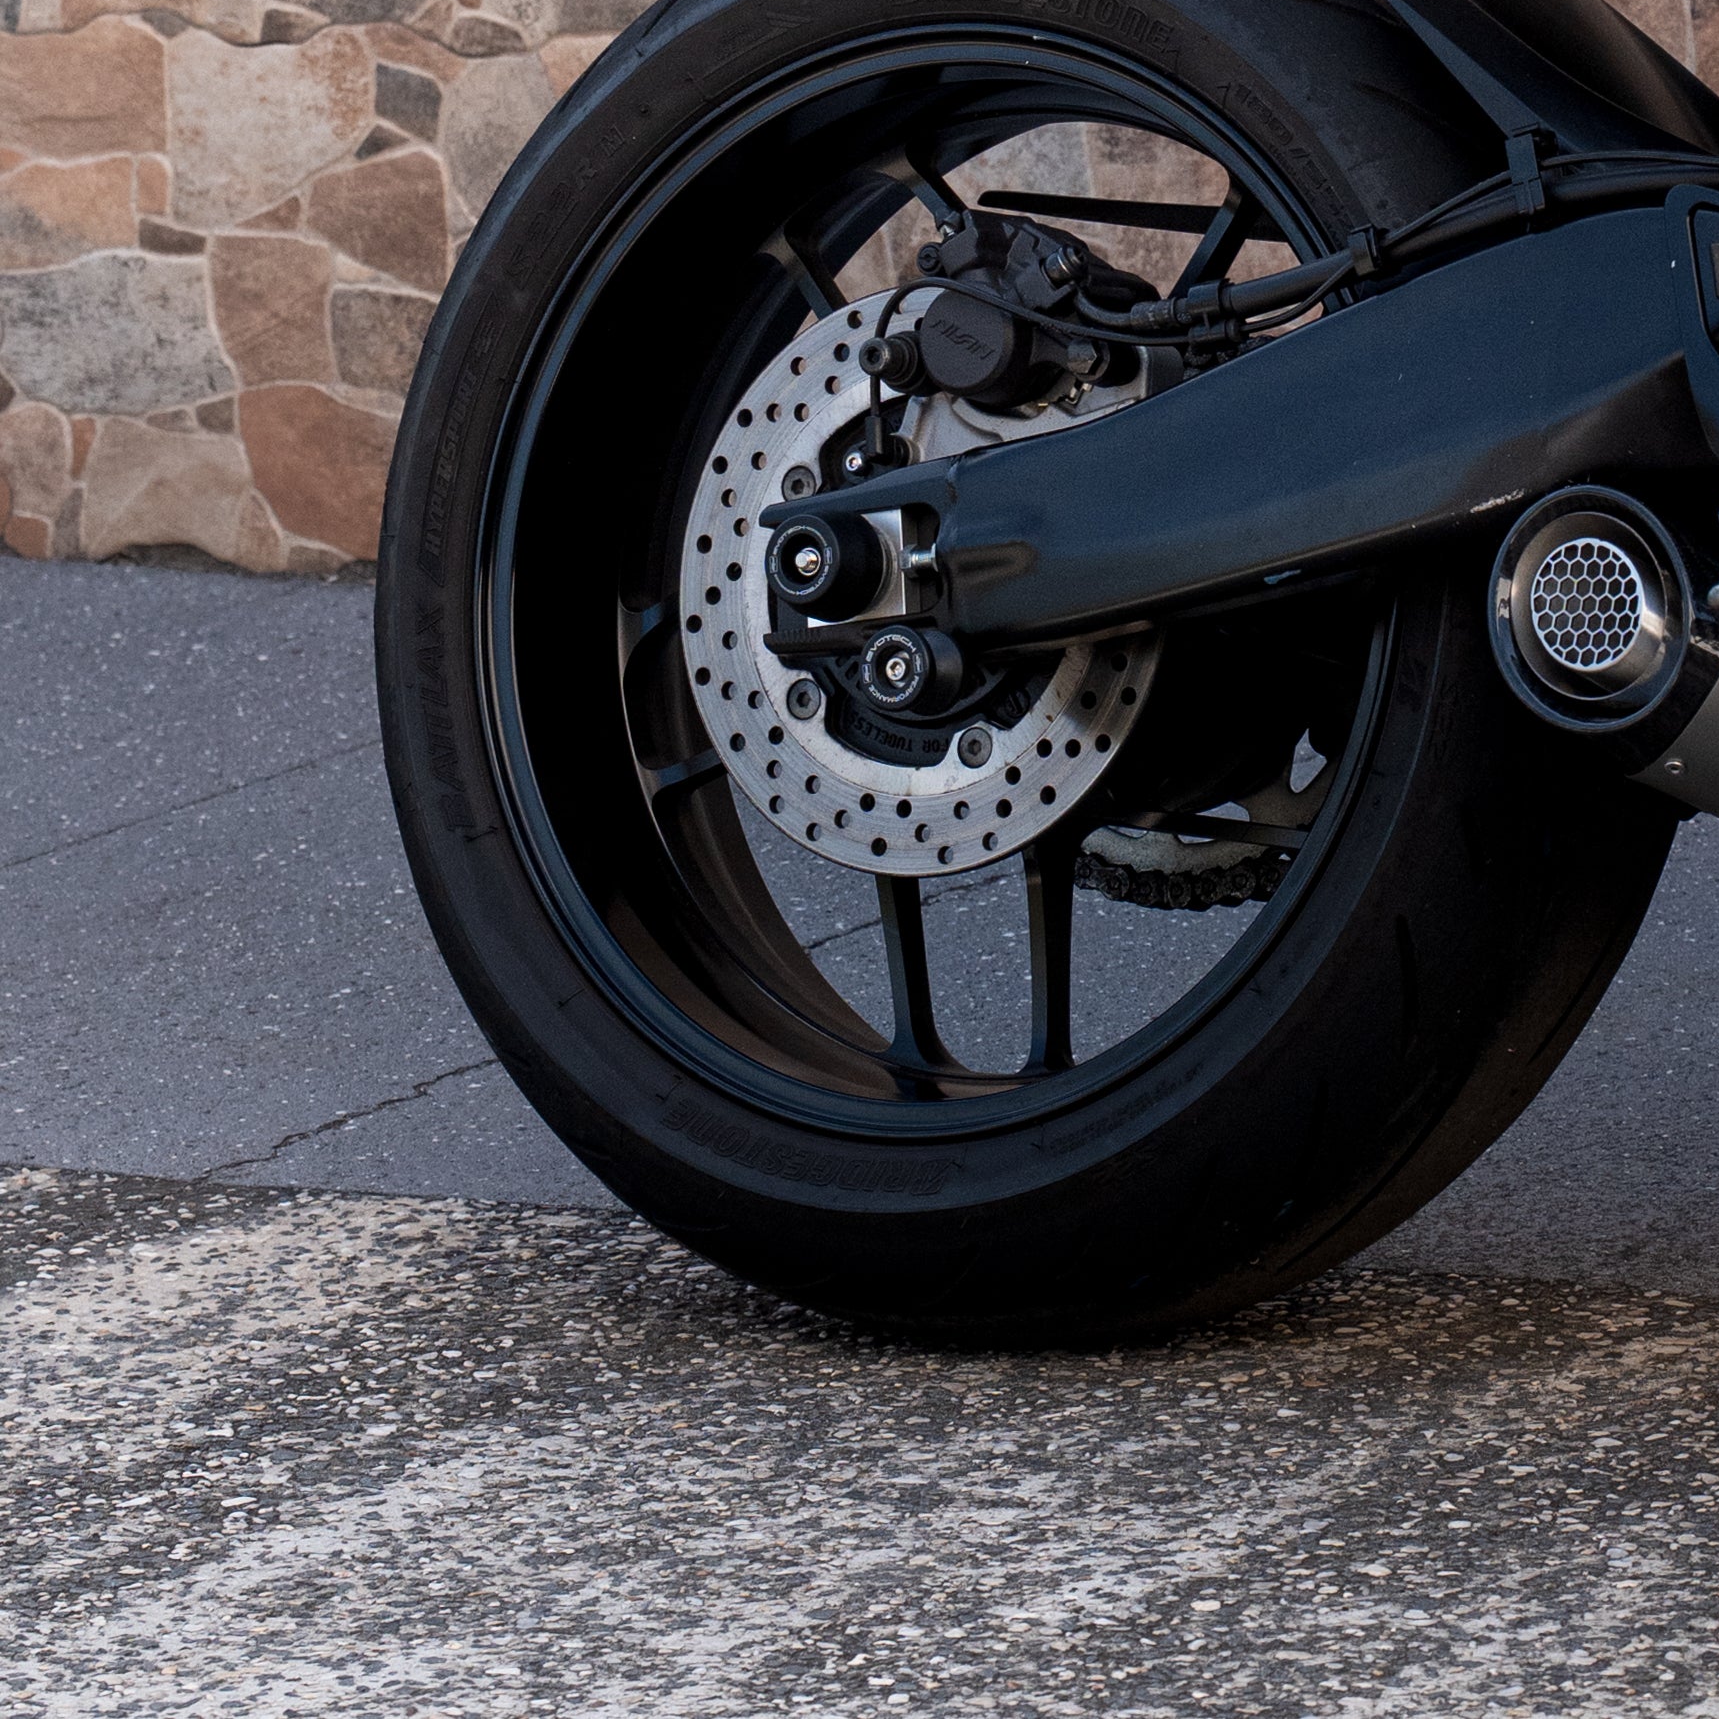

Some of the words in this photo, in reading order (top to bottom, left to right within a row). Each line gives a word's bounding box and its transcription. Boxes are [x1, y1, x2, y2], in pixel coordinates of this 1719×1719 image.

[423, 365, 478, 557] HYPERSPORT
[773, 525, 806, 555] EVOTECH
[865, 633, 917, 663] EVOTECH
[868, 675, 920, 703] PERFORMANCE
[848, 710, 913, 752] TUBELESS
[662, 1097, 950, 1195] BRIDGESTONE
